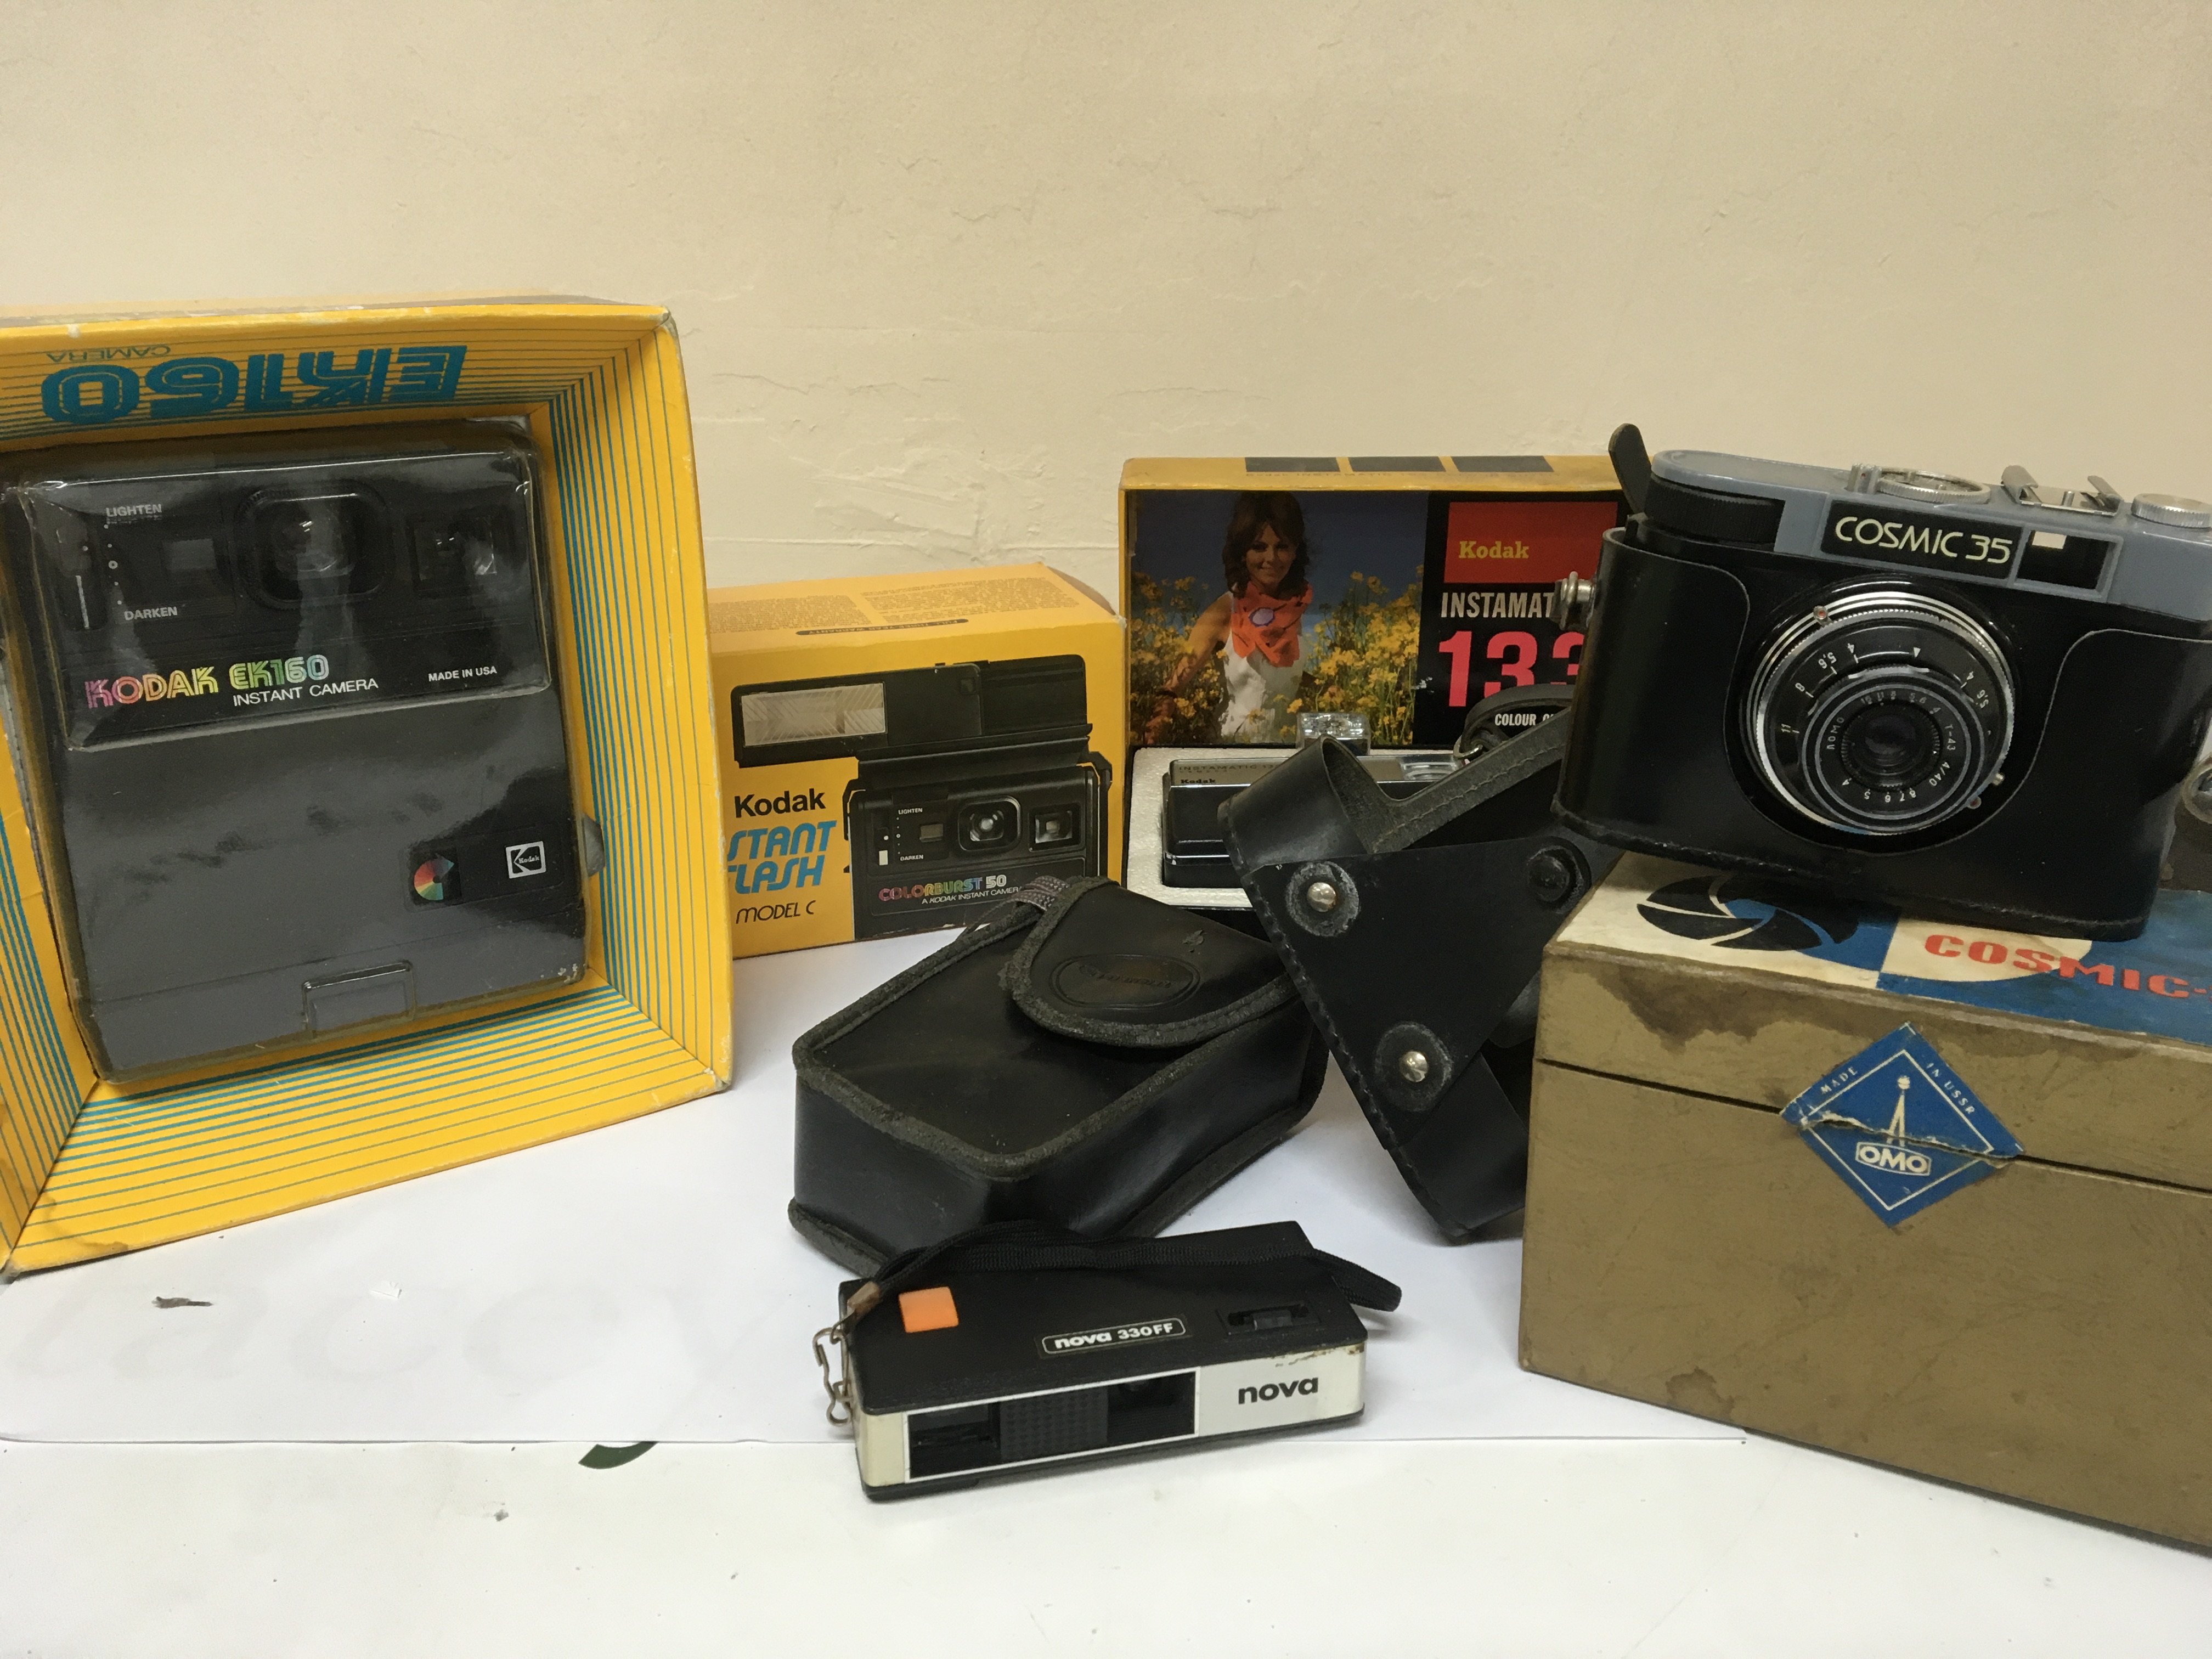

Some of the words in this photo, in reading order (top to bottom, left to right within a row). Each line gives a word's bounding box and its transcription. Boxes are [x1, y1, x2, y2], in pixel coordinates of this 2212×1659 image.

[46, 344, 171, 363] CAMERA
[41, 345, 467, 425] EK160
[106, 504, 162, 517] LIGHTEN
[1458, 541, 1530, 559] Kodak
[1835, 516, 1963, 557] COSMIC
[1965, 534, 2013, 563] 35
[124, 606, 178, 620] DARKEN
[1441, 592, 1555, 618] INSTAMAT
[84, 666, 219, 709] KODAK
[229, 654, 330, 690] EK160
[428, 670, 460, 682] MADE
[462, 668, 473, 678] IN
[475, 665, 498, 676] USA
[233, 686, 303, 707] INSTANT
[309, 678, 379, 697] CAMERA
[1795, 682, 1805, 692] 8
[1494, 713, 1537, 726] COLOUR
[734, 788, 826, 818] Kodak
[727, 820, 837, 862] STANT
[518, 855, 540, 864] Kodak
[727, 854, 825, 894] LASH
[878, 877, 983, 901] COLORBURST
[985, 874, 1007, 889] 50
[929, 895, 957, 904] KODAK
[958, 890, 990, 900] INSTANT
[736, 902, 801, 924] MODEL
[805, 900, 816, 915] C
[1820, 1066, 1858, 1094] MADE
[1926, 1062, 1942, 1077] IN
[1944, 1080, 1976, 1115] USSR
[1054, 1330, 1113, 1350] nova
[1238, 1376, 1319, 1405] nova
